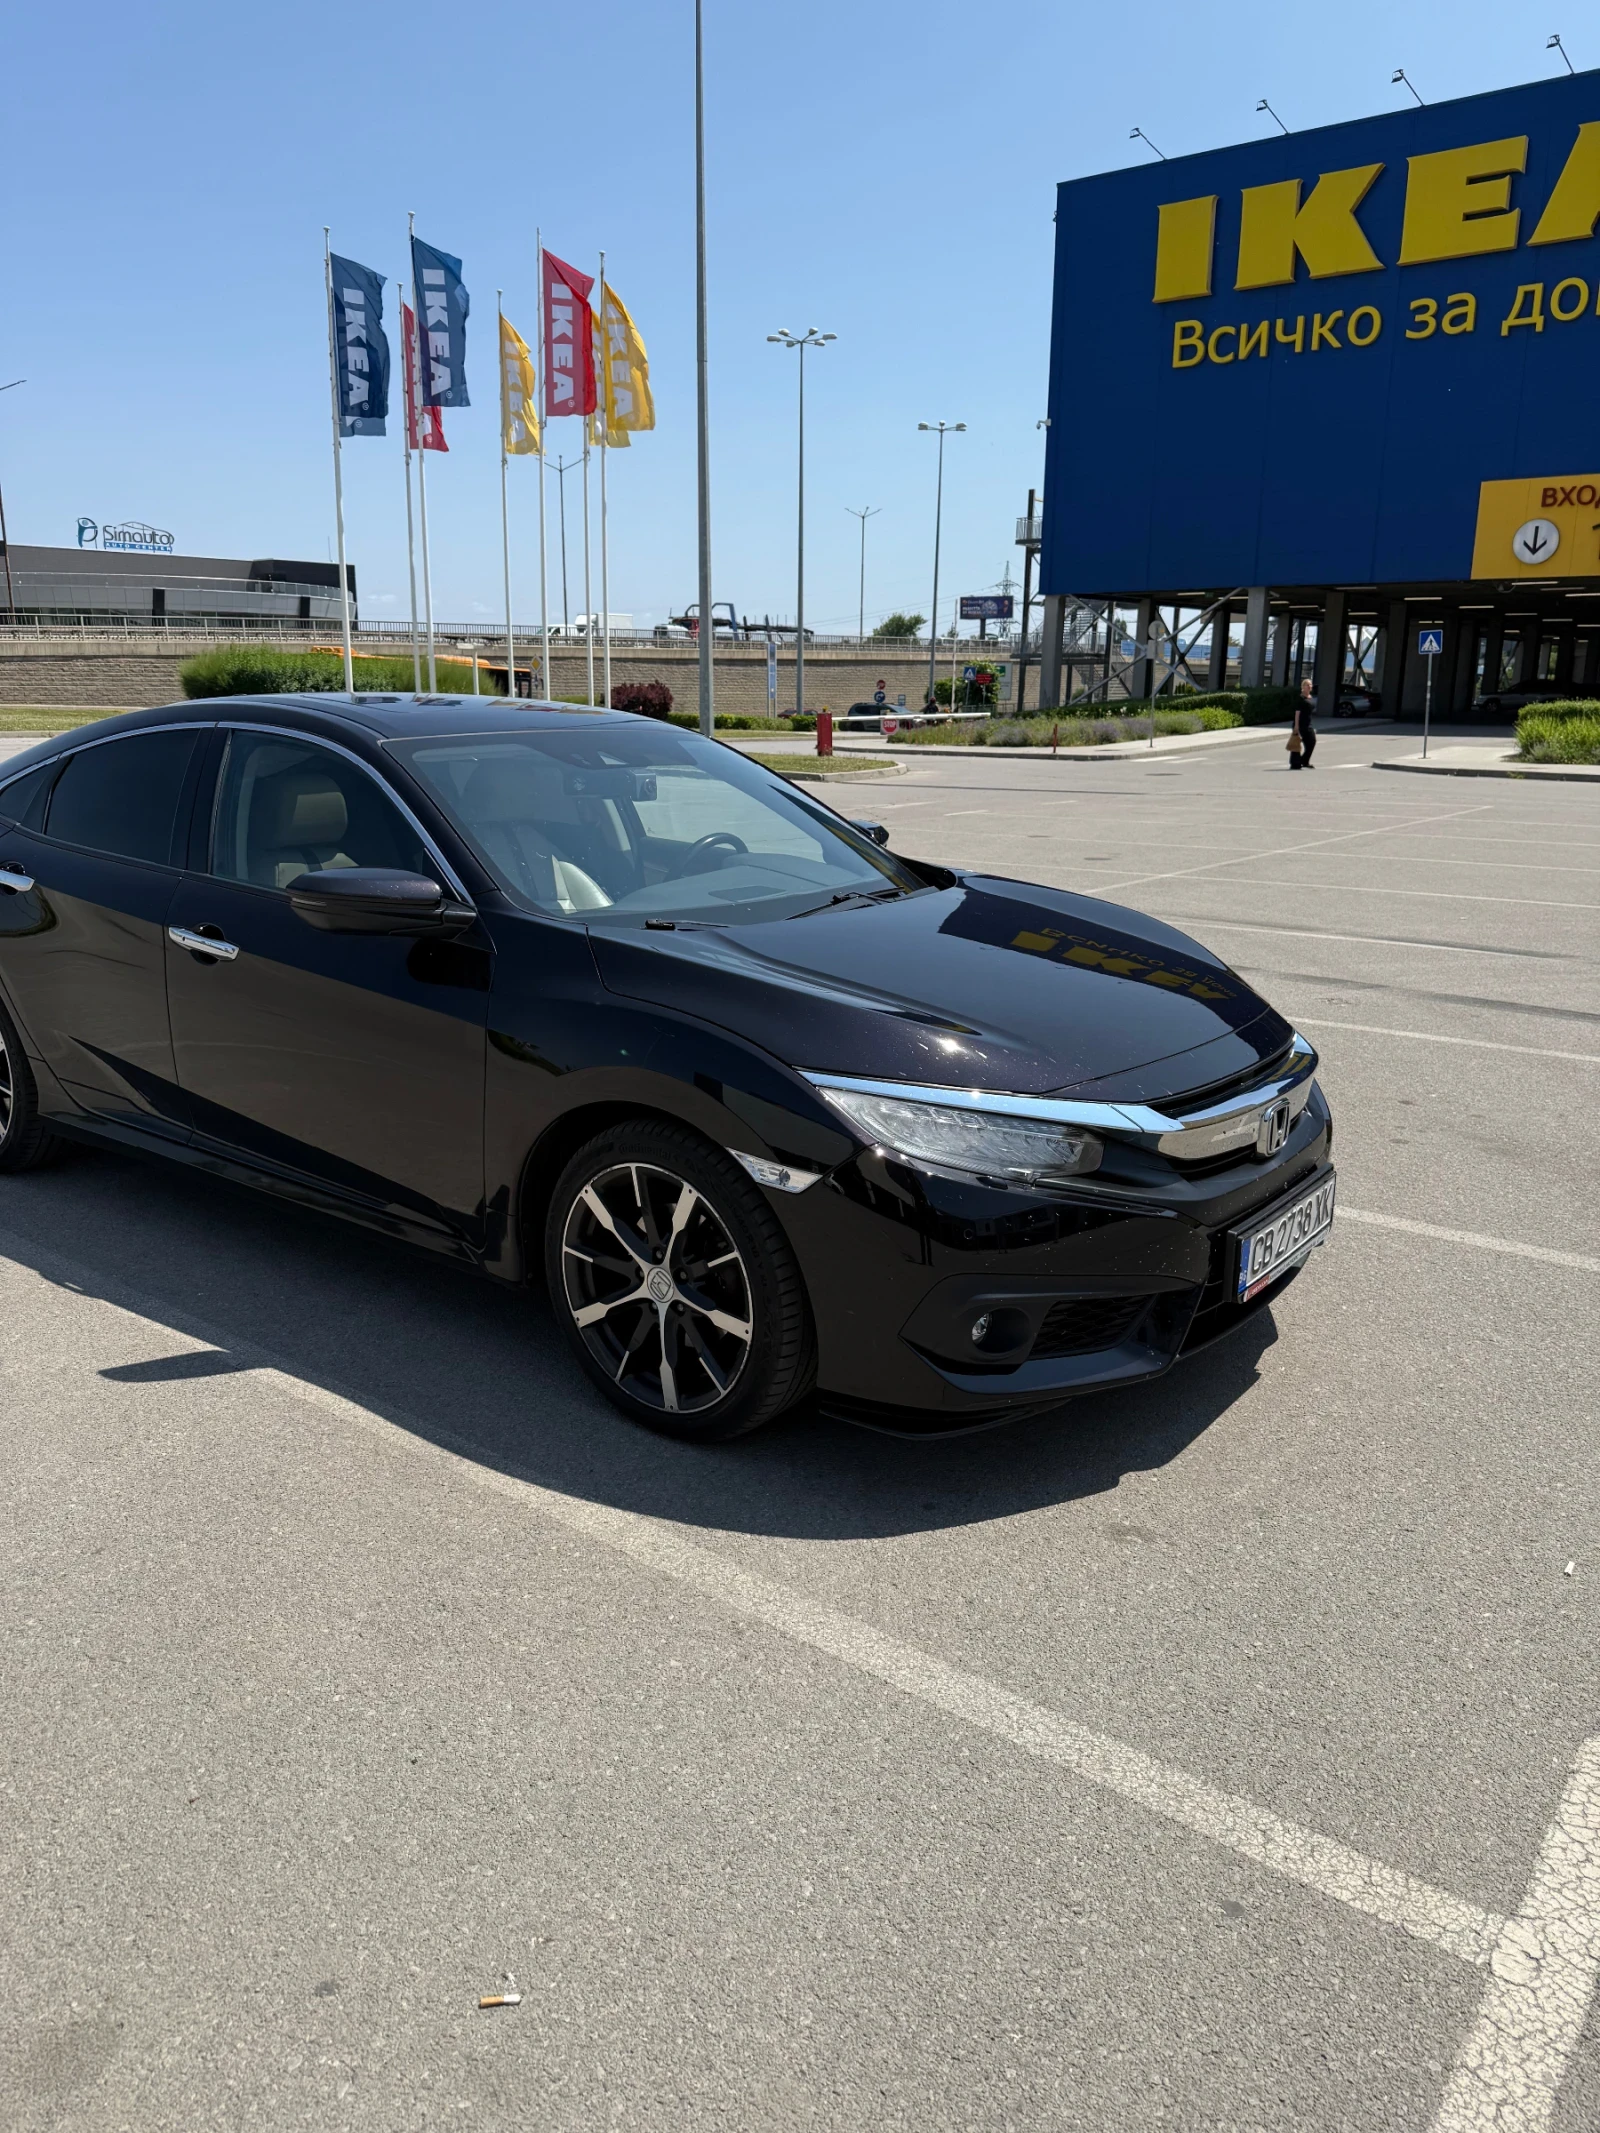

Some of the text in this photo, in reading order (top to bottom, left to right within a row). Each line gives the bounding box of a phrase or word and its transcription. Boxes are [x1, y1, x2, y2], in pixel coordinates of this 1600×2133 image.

[343, 287, 370, 406] IKEA
[422, 268, 451, 396] IKEA
[551, 282, 574, 405] IKEA
[607, 303, 633, 420] IKEA
[1172, 277, 1600, 369] Всичко за до
[505, 341, 526, 444] IKEA
[104, 525, 170, 545] Simauto
[1541, 484, 1600, 509] ВХО
[884, 720, 896, 728] STOP
[618, 1142, 671, 1160] Continental
[1251, 1227, 1274, 1275] CB
[1274, 1199, 1313, 1259] 2738
